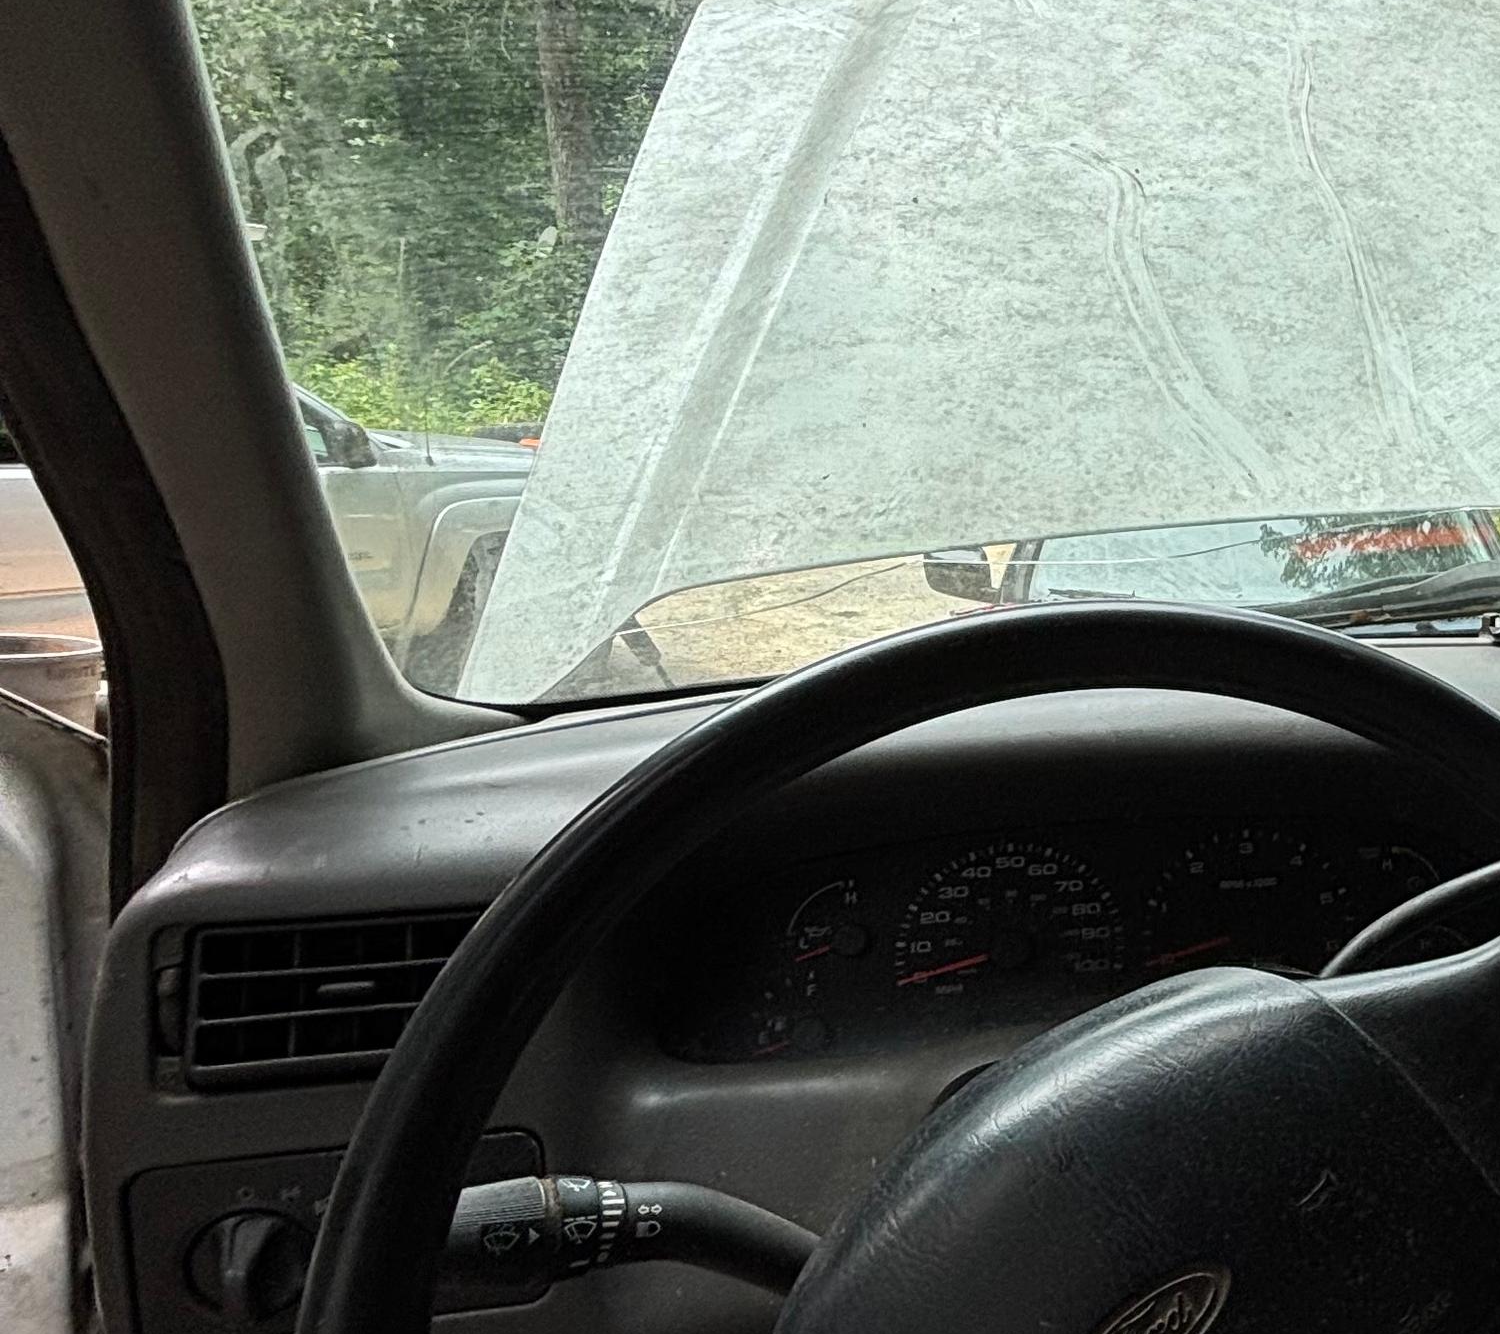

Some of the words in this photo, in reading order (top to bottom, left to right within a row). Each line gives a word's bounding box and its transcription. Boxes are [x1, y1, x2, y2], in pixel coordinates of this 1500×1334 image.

[995, 856, 1026, 868] 50
[961, 867, 992, 878] 40
[1028, 864, 1058, 876] 60
[938, 885, 970, 899] 30
[1054, 880, 1085, 892] 70
[919, 910, 951, 925] 20
[909, 940, 933, 954] 10
